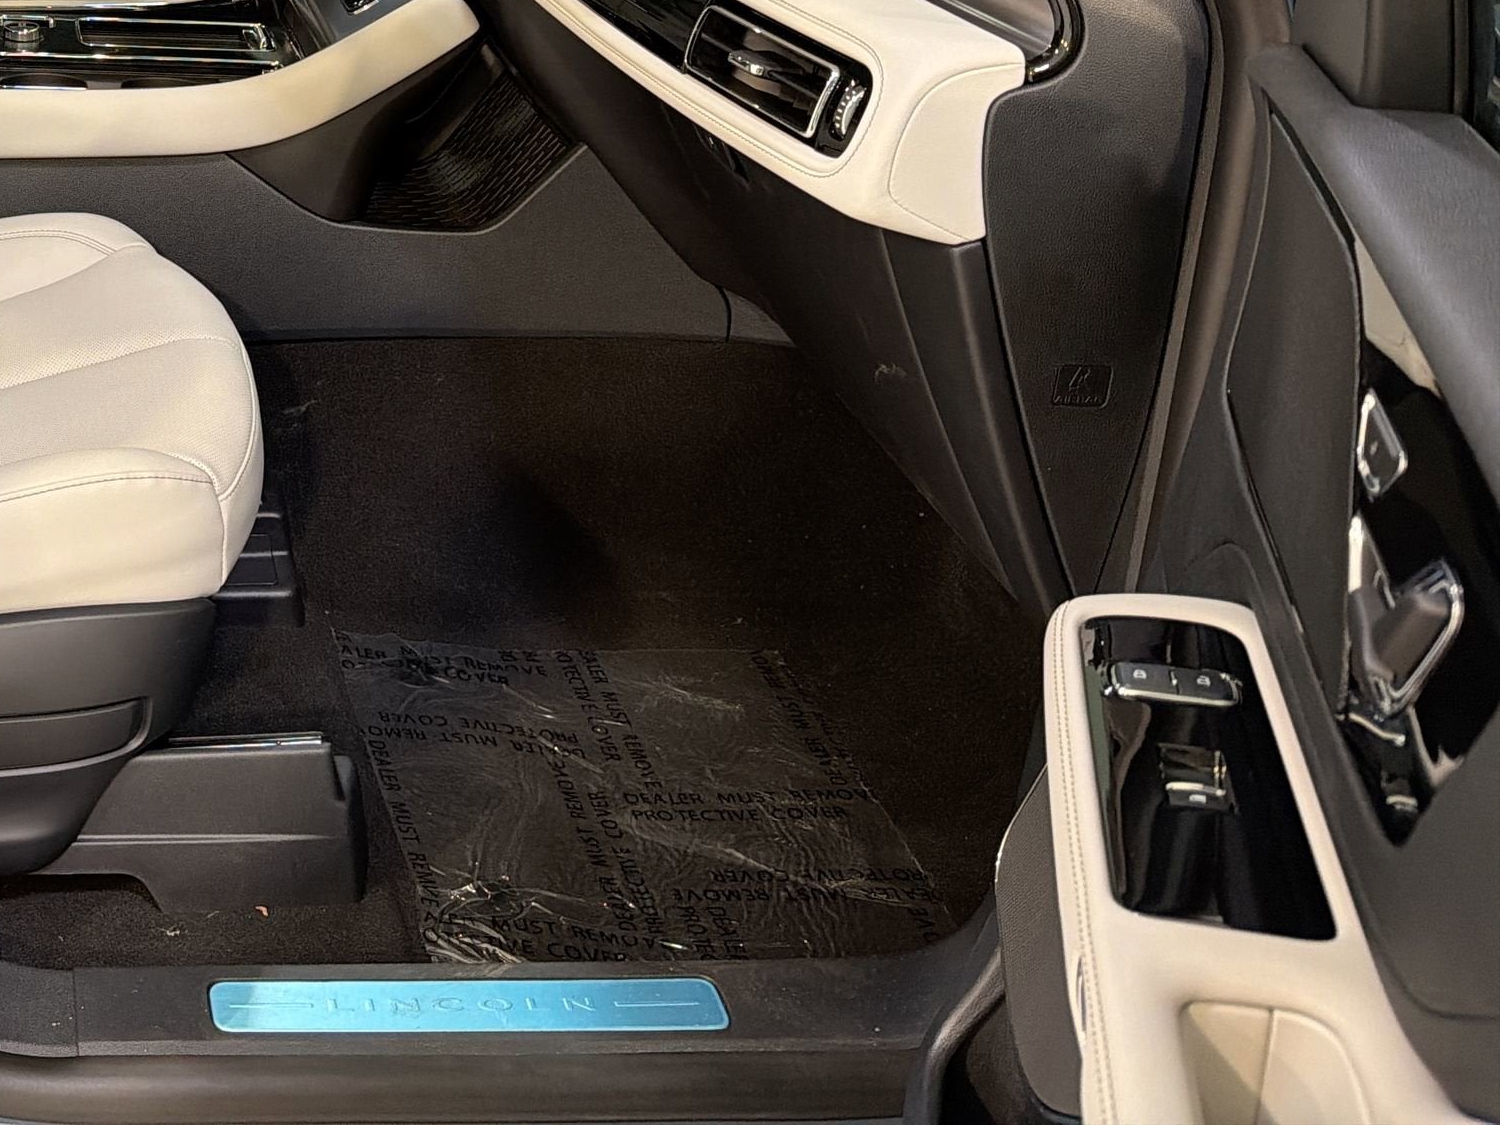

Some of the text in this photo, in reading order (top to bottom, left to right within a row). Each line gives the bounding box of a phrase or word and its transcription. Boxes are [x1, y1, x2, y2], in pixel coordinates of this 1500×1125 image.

[377, 711, 449, 727] COVER
[438, 731, 498, 747] MUST
[623, 792, 705, 805] DEALER
[717, 791, 776, 805] MUST
[633, 806, 848, 822] PROTECTIVE COVER
[389, 801, 421, 845] MUST
[671, 887, 769, 901] REMOVE
[326, 997, 595, 1013] LINCOLN
